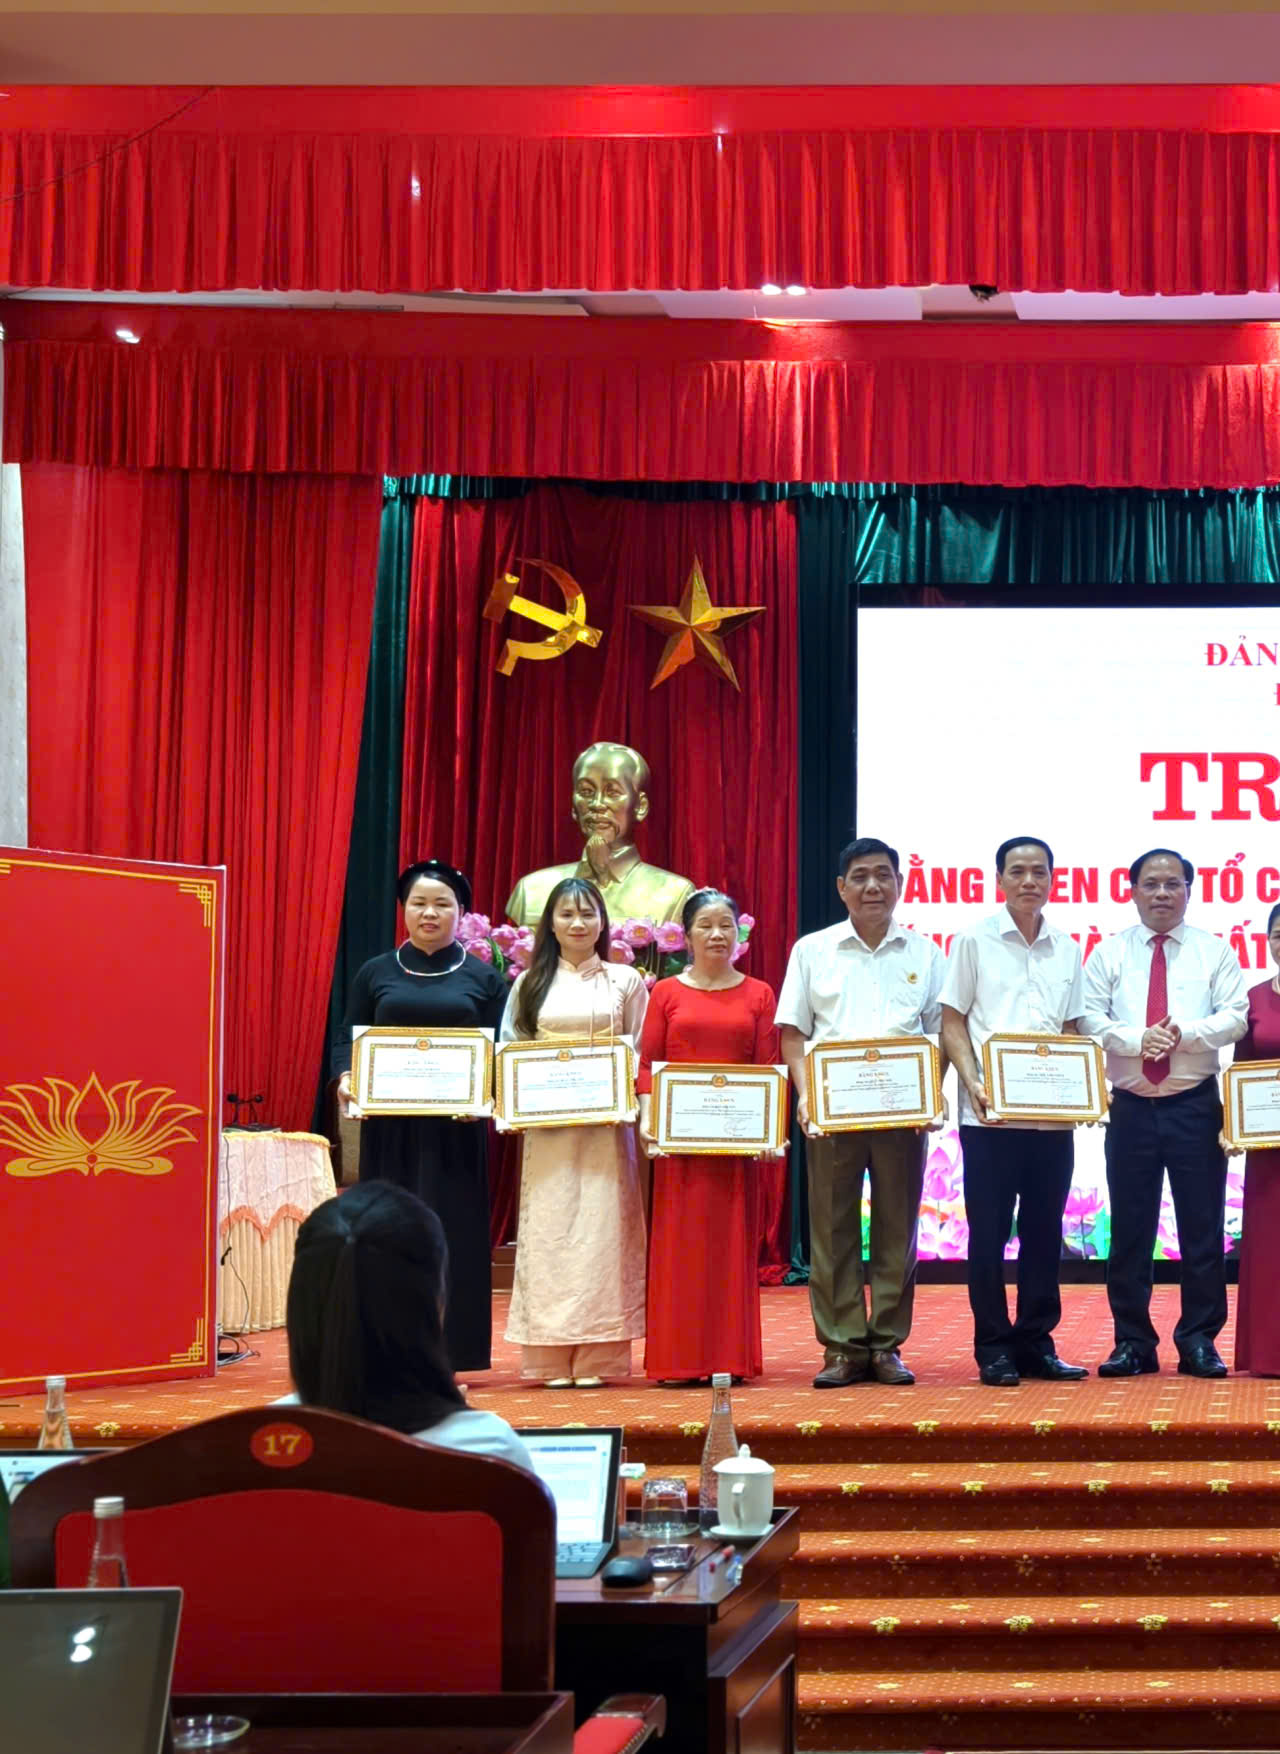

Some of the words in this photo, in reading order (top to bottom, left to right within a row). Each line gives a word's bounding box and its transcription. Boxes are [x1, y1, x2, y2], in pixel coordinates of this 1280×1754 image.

[903, 854, 984, 903] ẰNG
[1198, 852, 1246, 903] TỔ
[263, 1433, 302, 1456] 17
